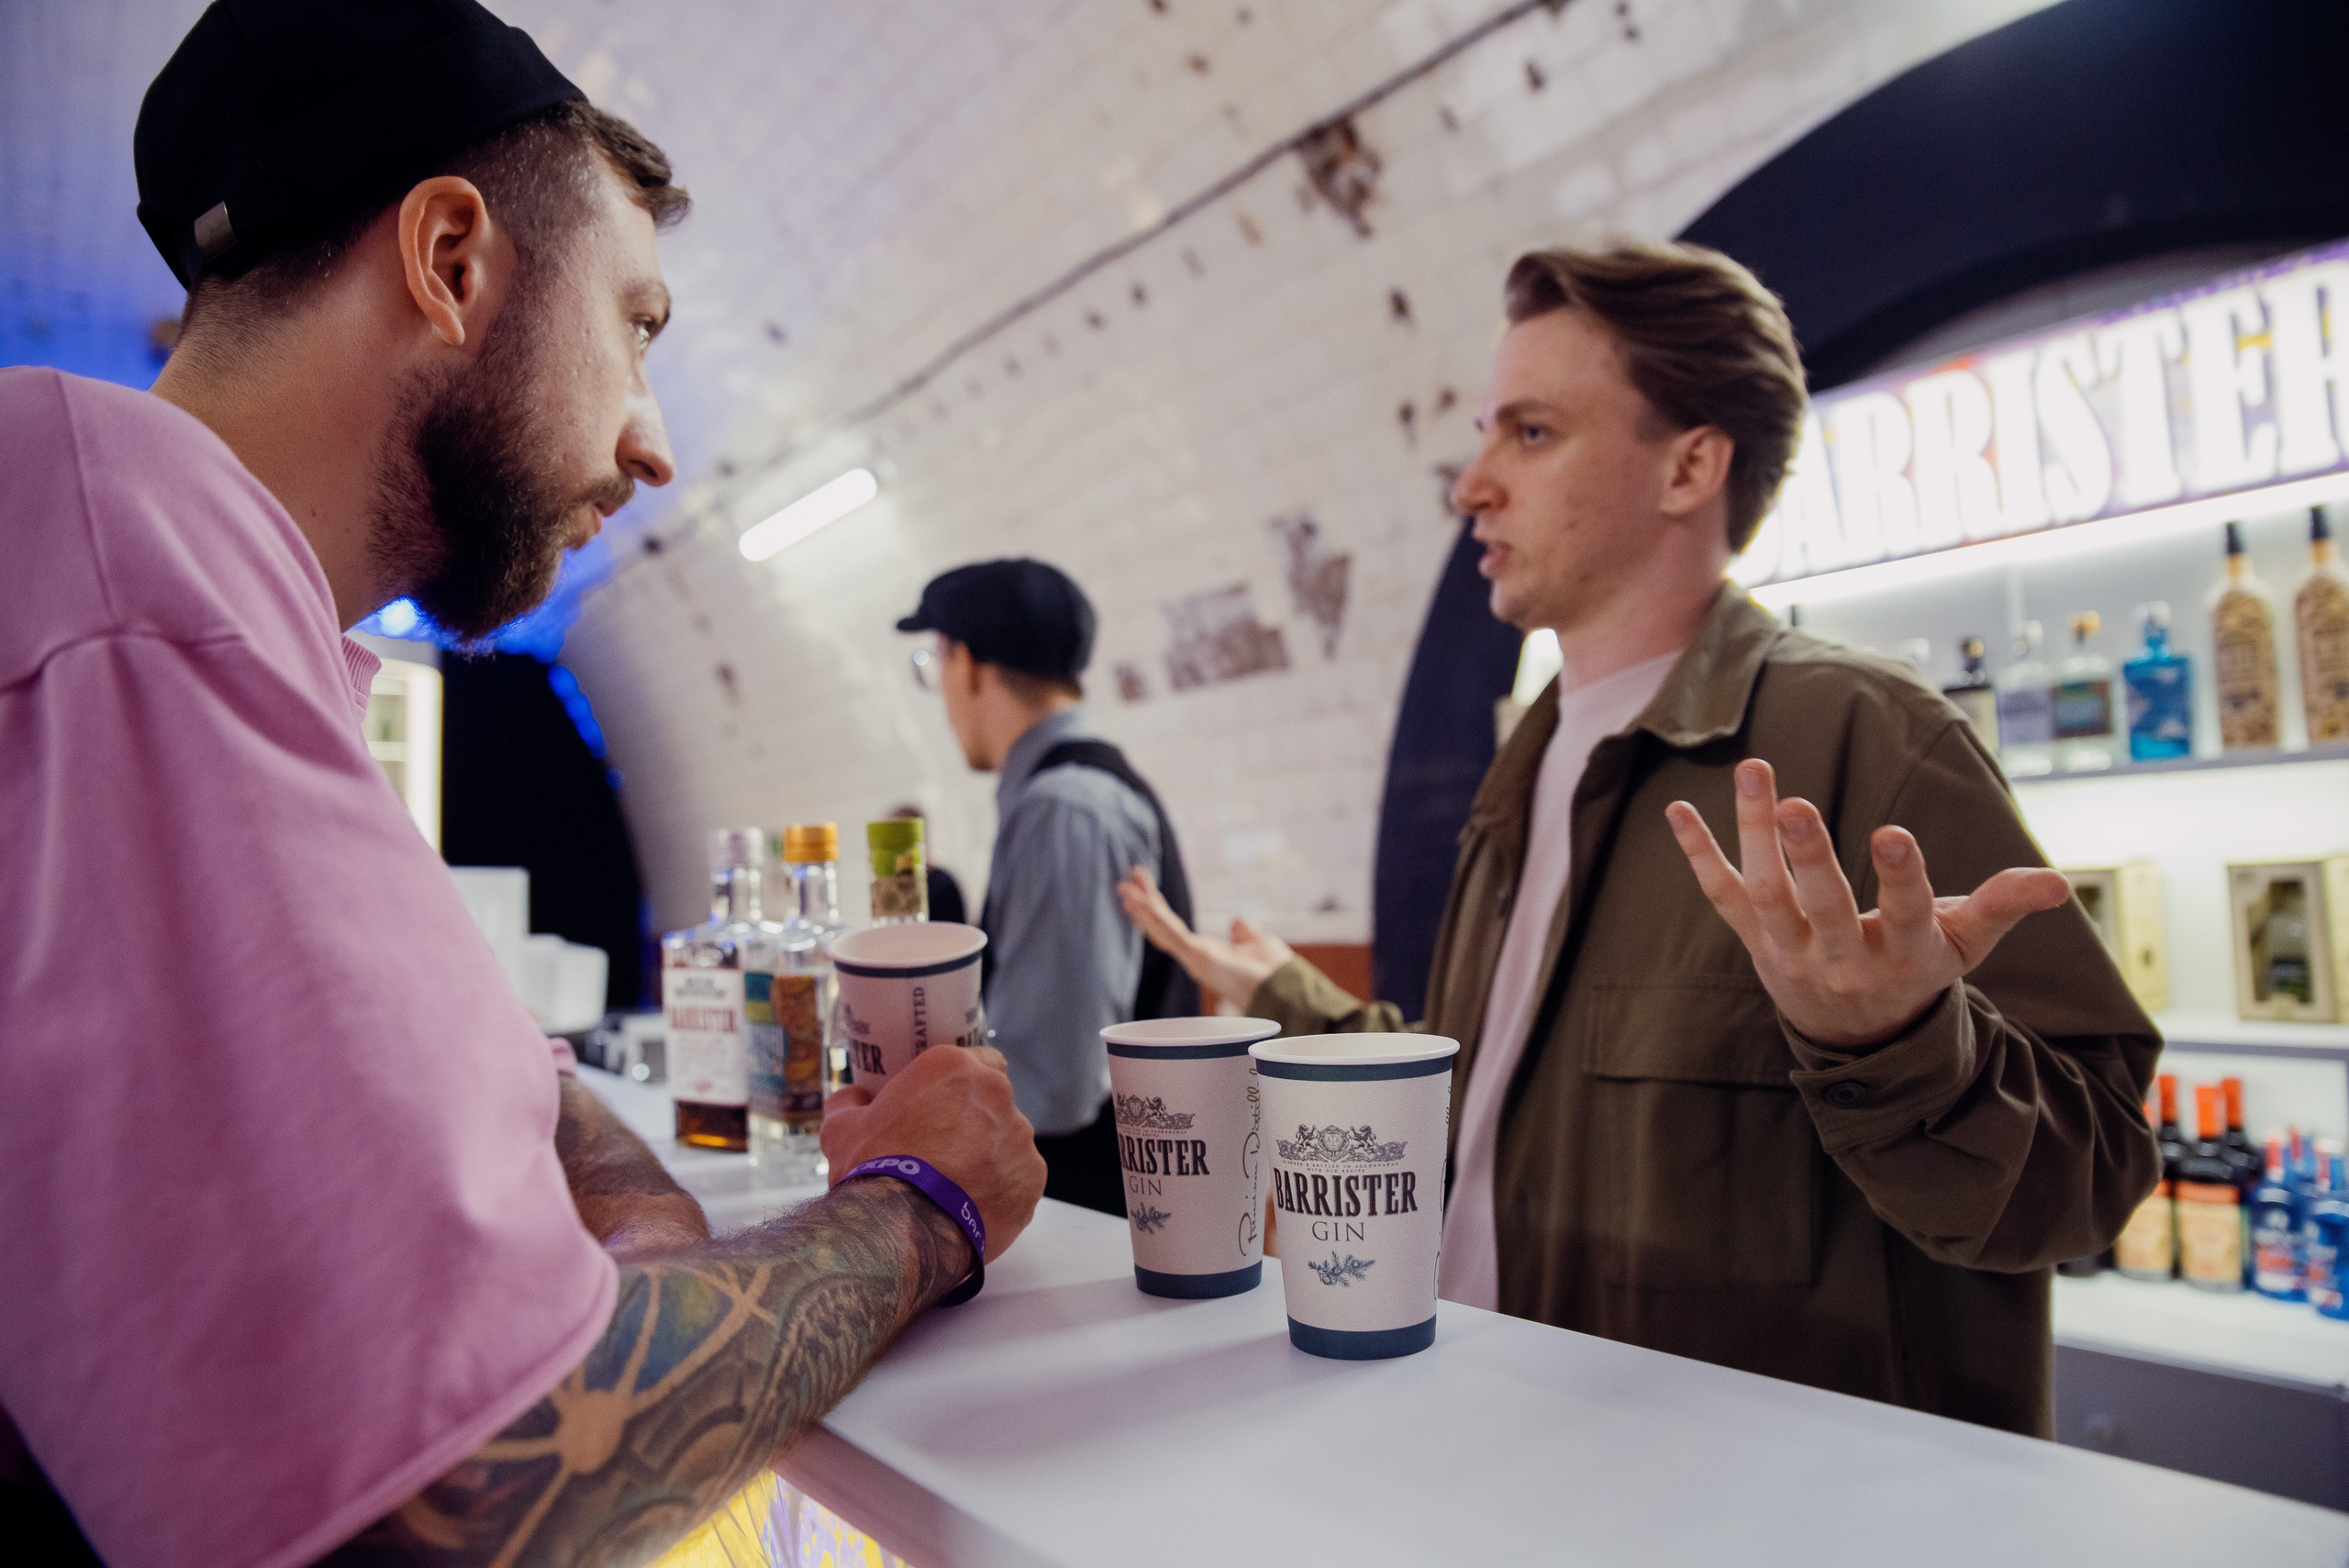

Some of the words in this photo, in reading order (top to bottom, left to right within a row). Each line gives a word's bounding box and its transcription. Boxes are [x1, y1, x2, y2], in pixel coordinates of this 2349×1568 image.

[1732, 258, 2349, 587] ARRISTER
[1119, 1133, 1210, 1176] RRISTER
[1129, 1175, 1162, 1195] GIN
[1273, 1167, 1419, 1218] BARRISTER
[1311, 1220, 1365, 1242] GIN
